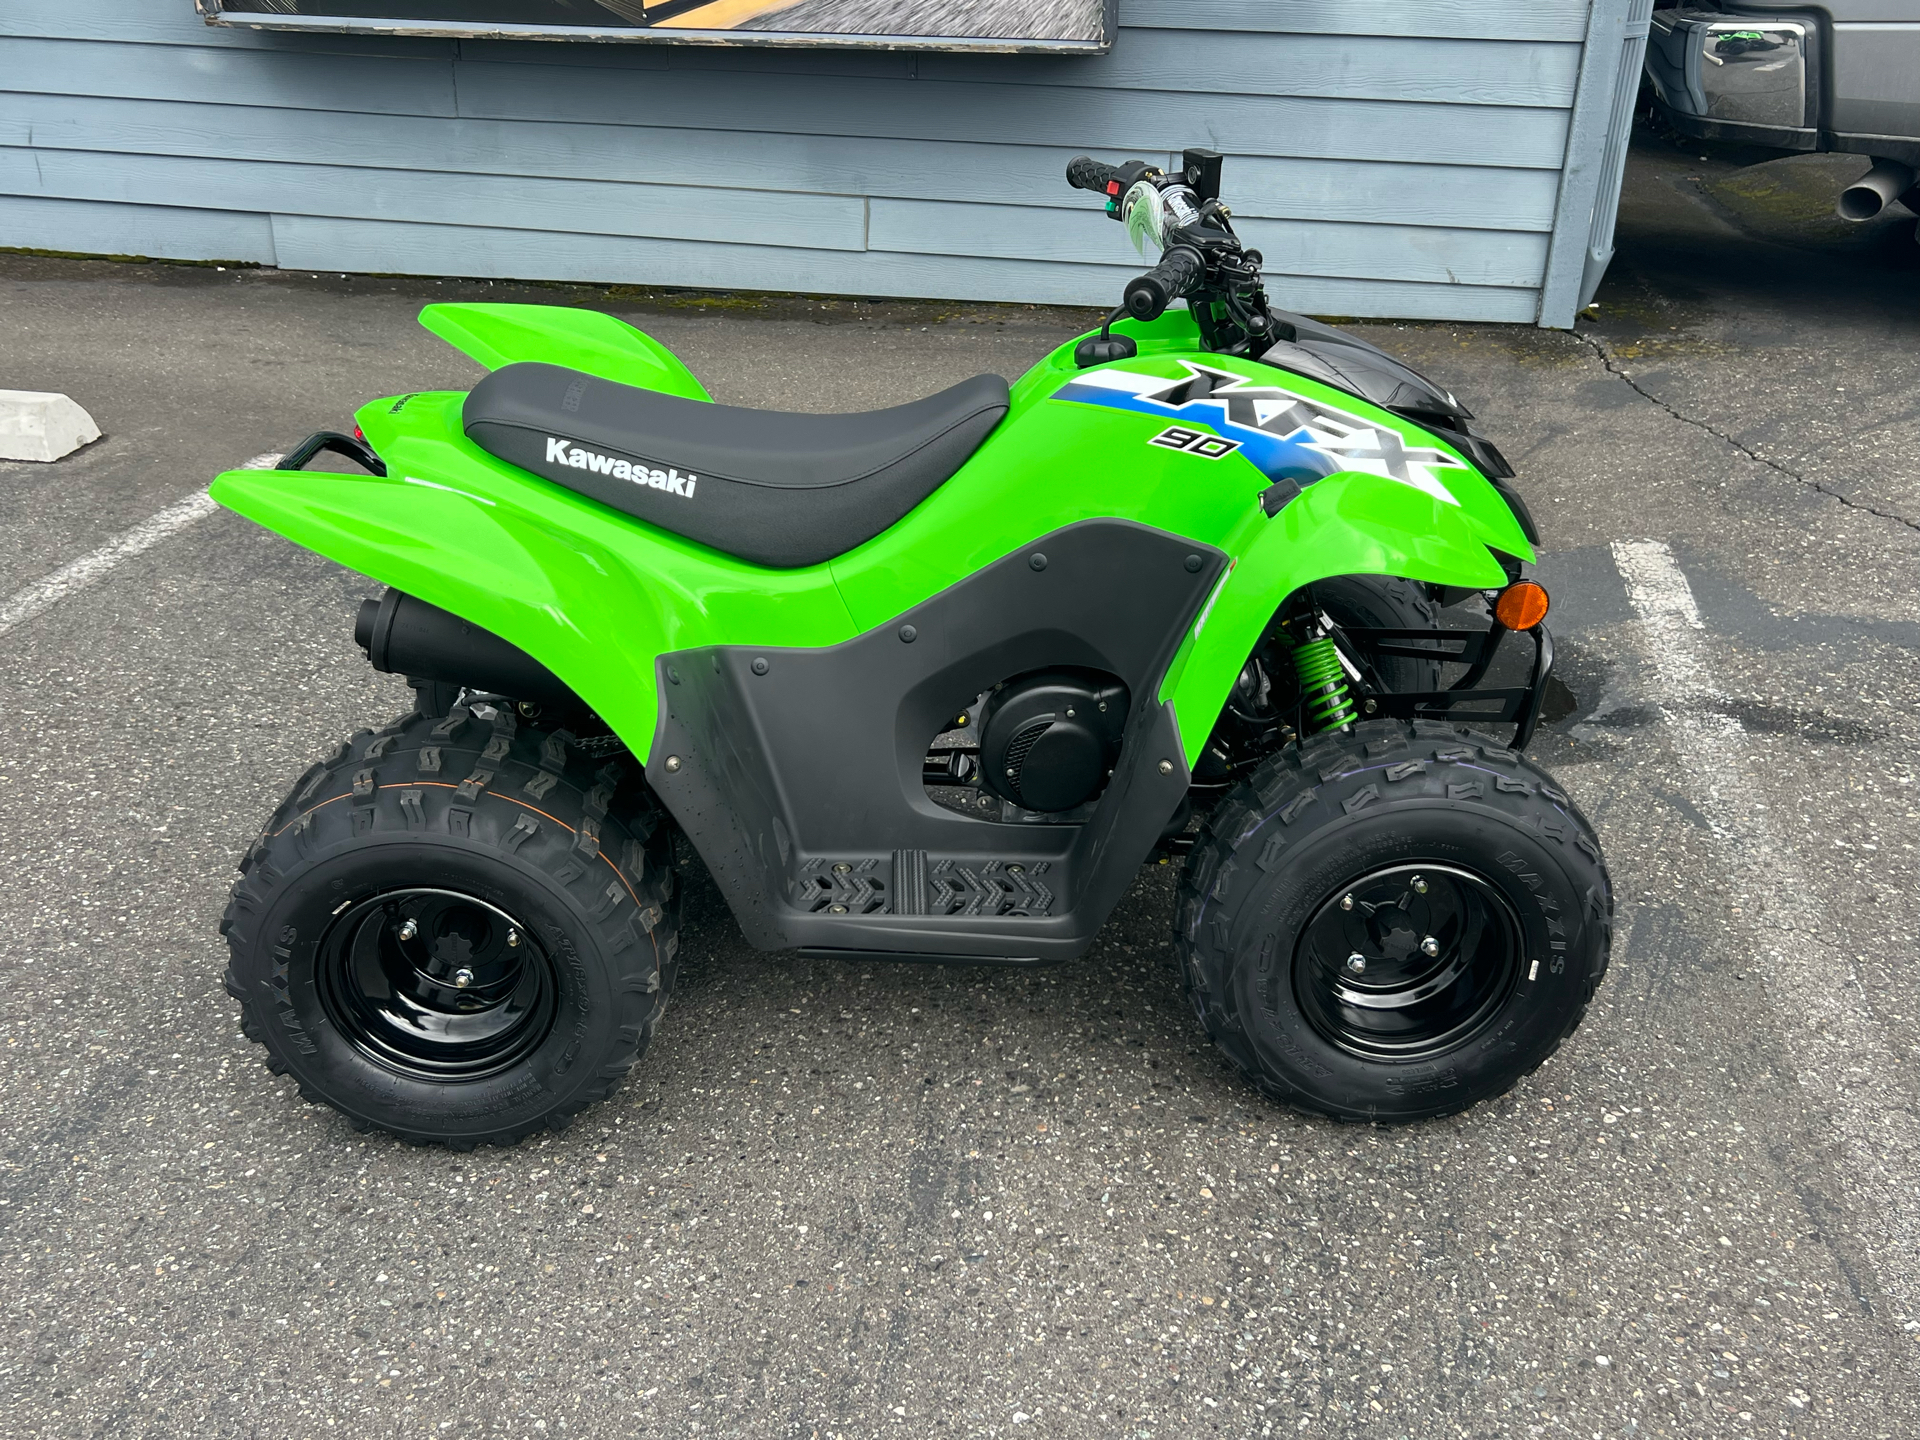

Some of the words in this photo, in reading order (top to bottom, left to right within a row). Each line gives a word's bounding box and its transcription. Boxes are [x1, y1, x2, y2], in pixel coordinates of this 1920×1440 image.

[546, 437, 697, 499] Kawasaki
[1132, 359, 1469, 507] KFX
[1148, 426, 1244, 460] 90
[1495, 850, 1565, 976] MAXXIS
[271, 924, 318, 1056] MAXXIS
